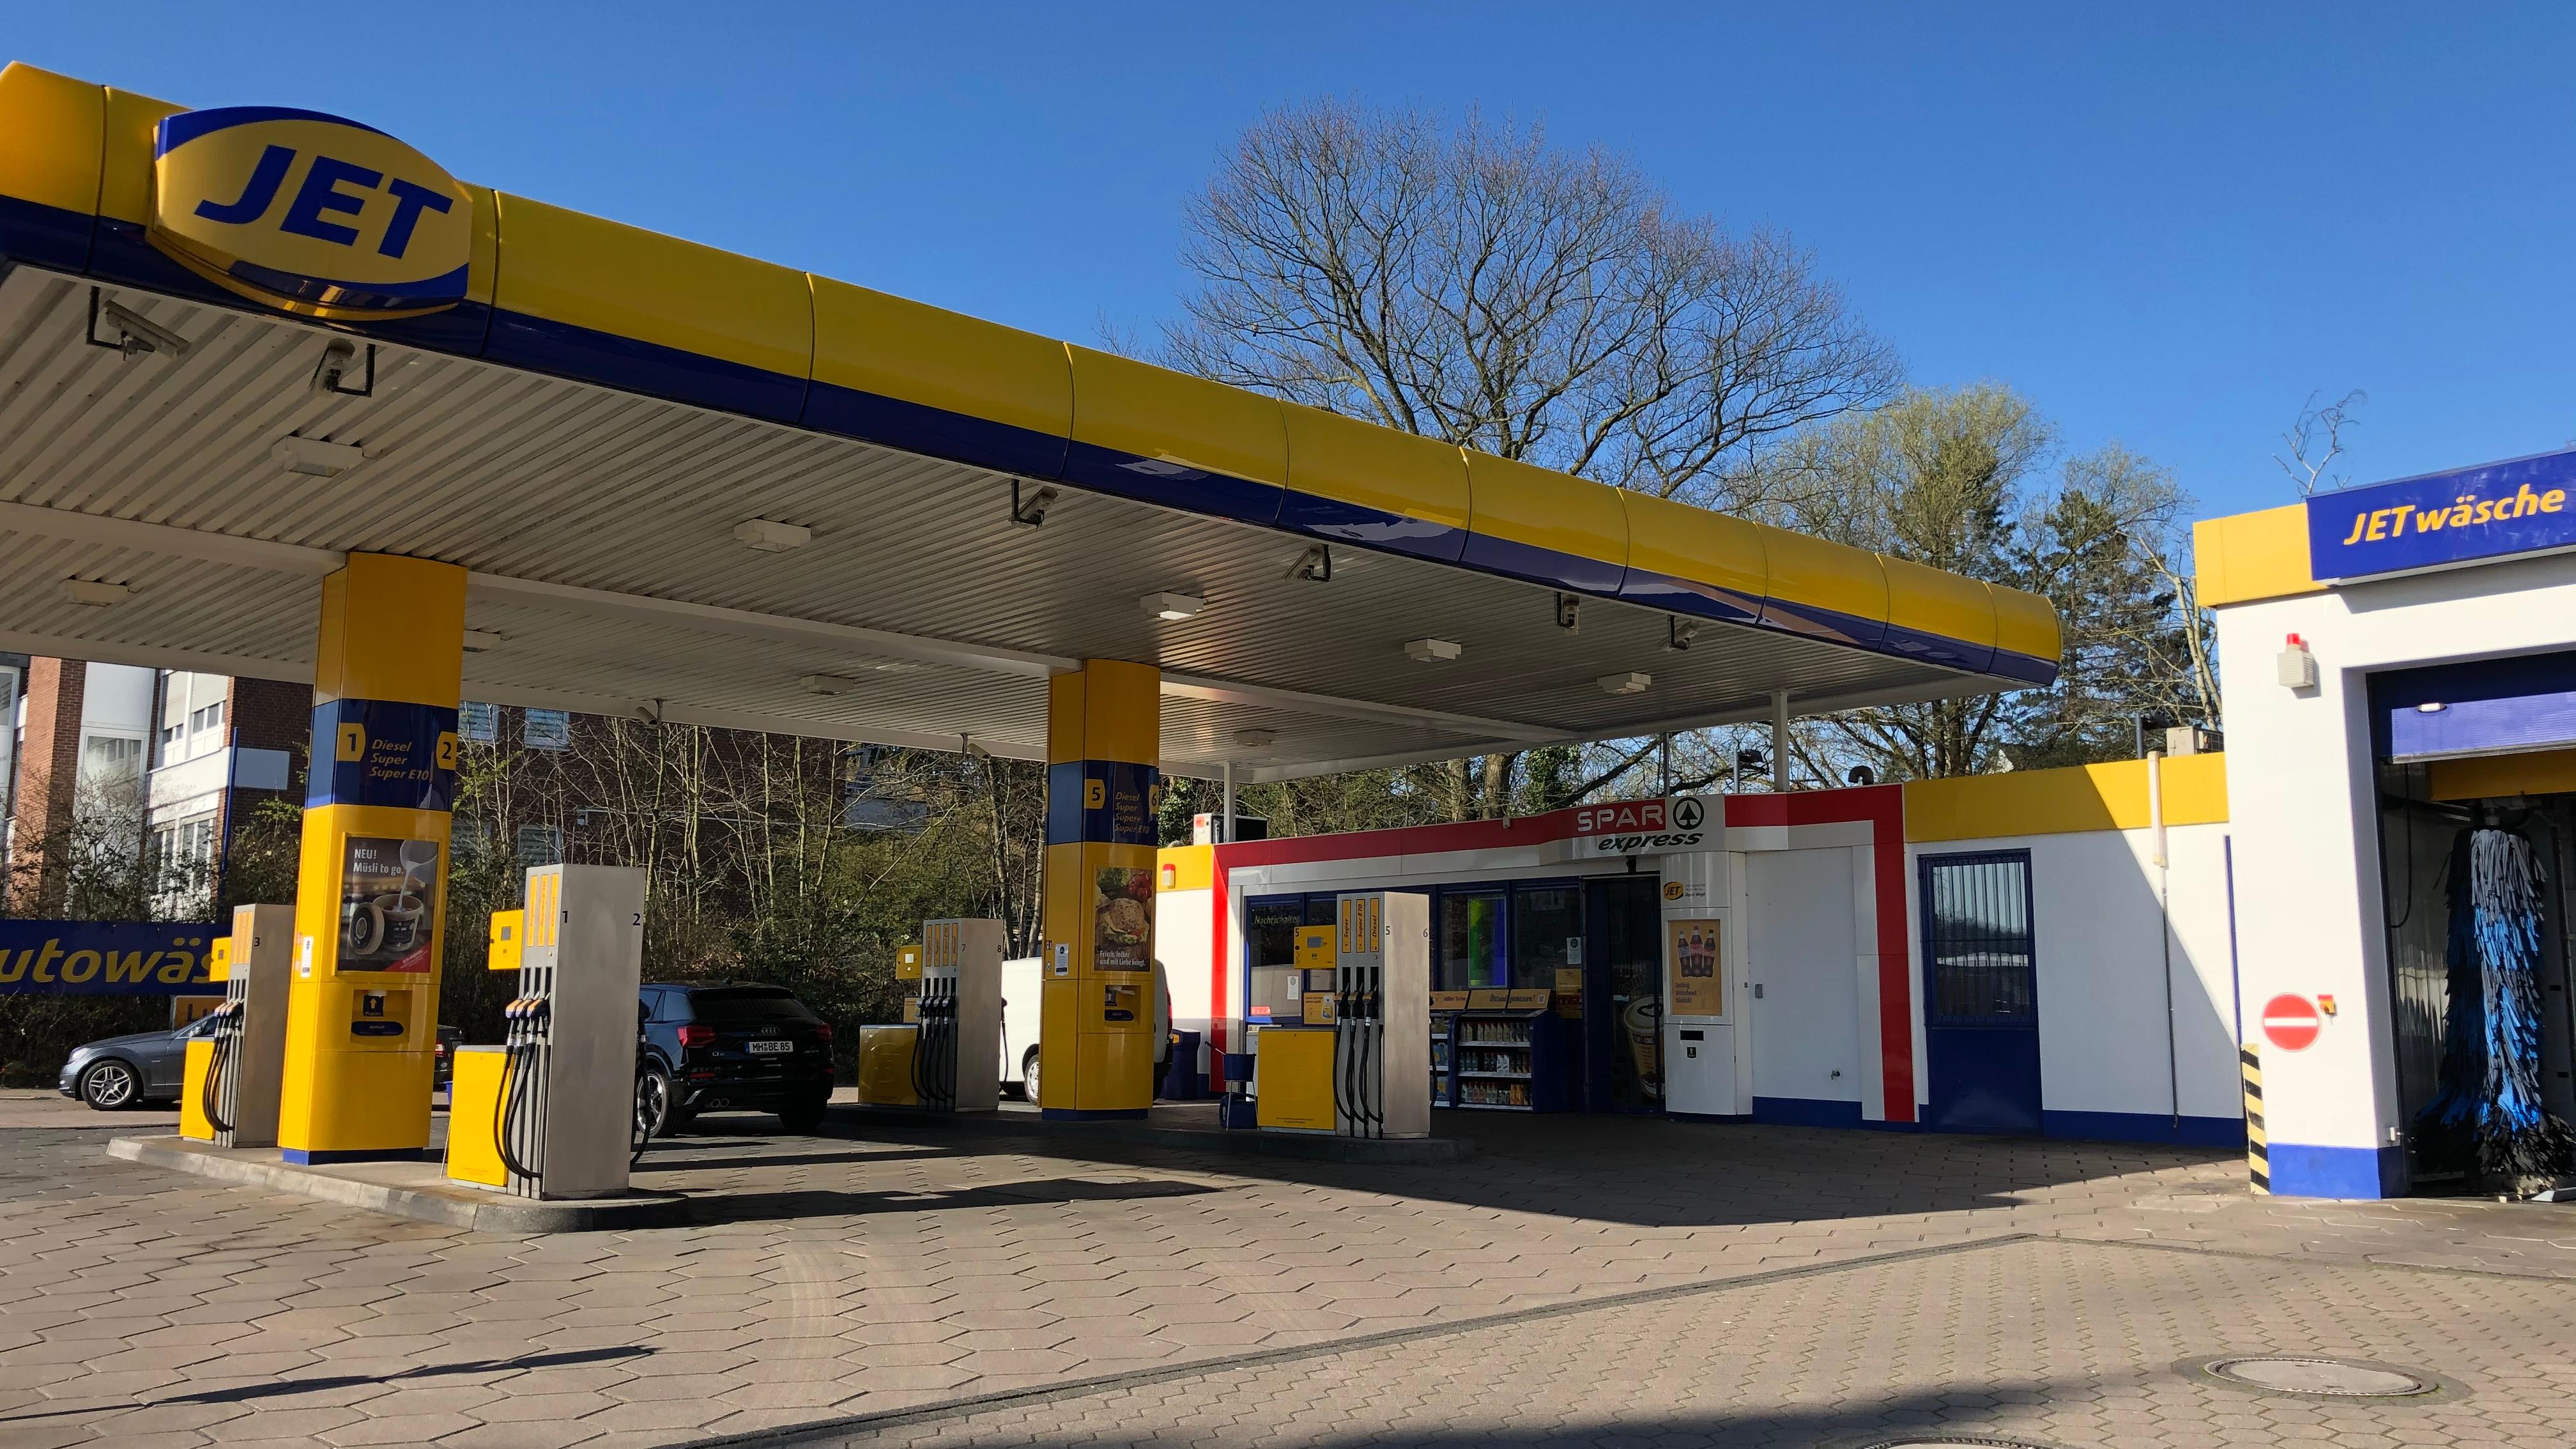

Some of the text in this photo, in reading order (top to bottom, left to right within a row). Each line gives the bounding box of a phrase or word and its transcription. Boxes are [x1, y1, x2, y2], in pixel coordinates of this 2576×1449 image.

[194, 144, 454, 259] JET
[347, 733, 357, 752] 1
[371, 739, 413, 752] Diesel
[441, 741, 452, 760] 2
[370, 753, 408, 767] Super
[369, 766, 429, 781] Super E10
[1091, 786, 1101, 801] 5
[1114, 792, 1140, 802] Diesel
[1151, 792, 1157, 806] 6
[1114, 802, 1138, 813] Super
[1114, 813, 1141, 824] Super+
[1577, 804, 1663, 832] SPAR
[1114, 823, 1150, 834] Super E10
[1598, 832, 1705, 852] express
[354, 848, 377, 859] NEU!
[353, 862, 404, 877] Müsli to go.
[1665, 885, 1682, 896] JET
[562, 910, 569, 924] 1
[632, 912, 641, 926] 2
[1295, 928, 1300, 937] 5
[1385, 926, 1390, 935] 5
[1423, 928, 1428, 938] 6
[254, 937, 261, 947] 3
[961, 944, 966, 952] 7
[997, 944, 1002, 953] 8
[752, 1042, 790, 1052] MH BE 85
